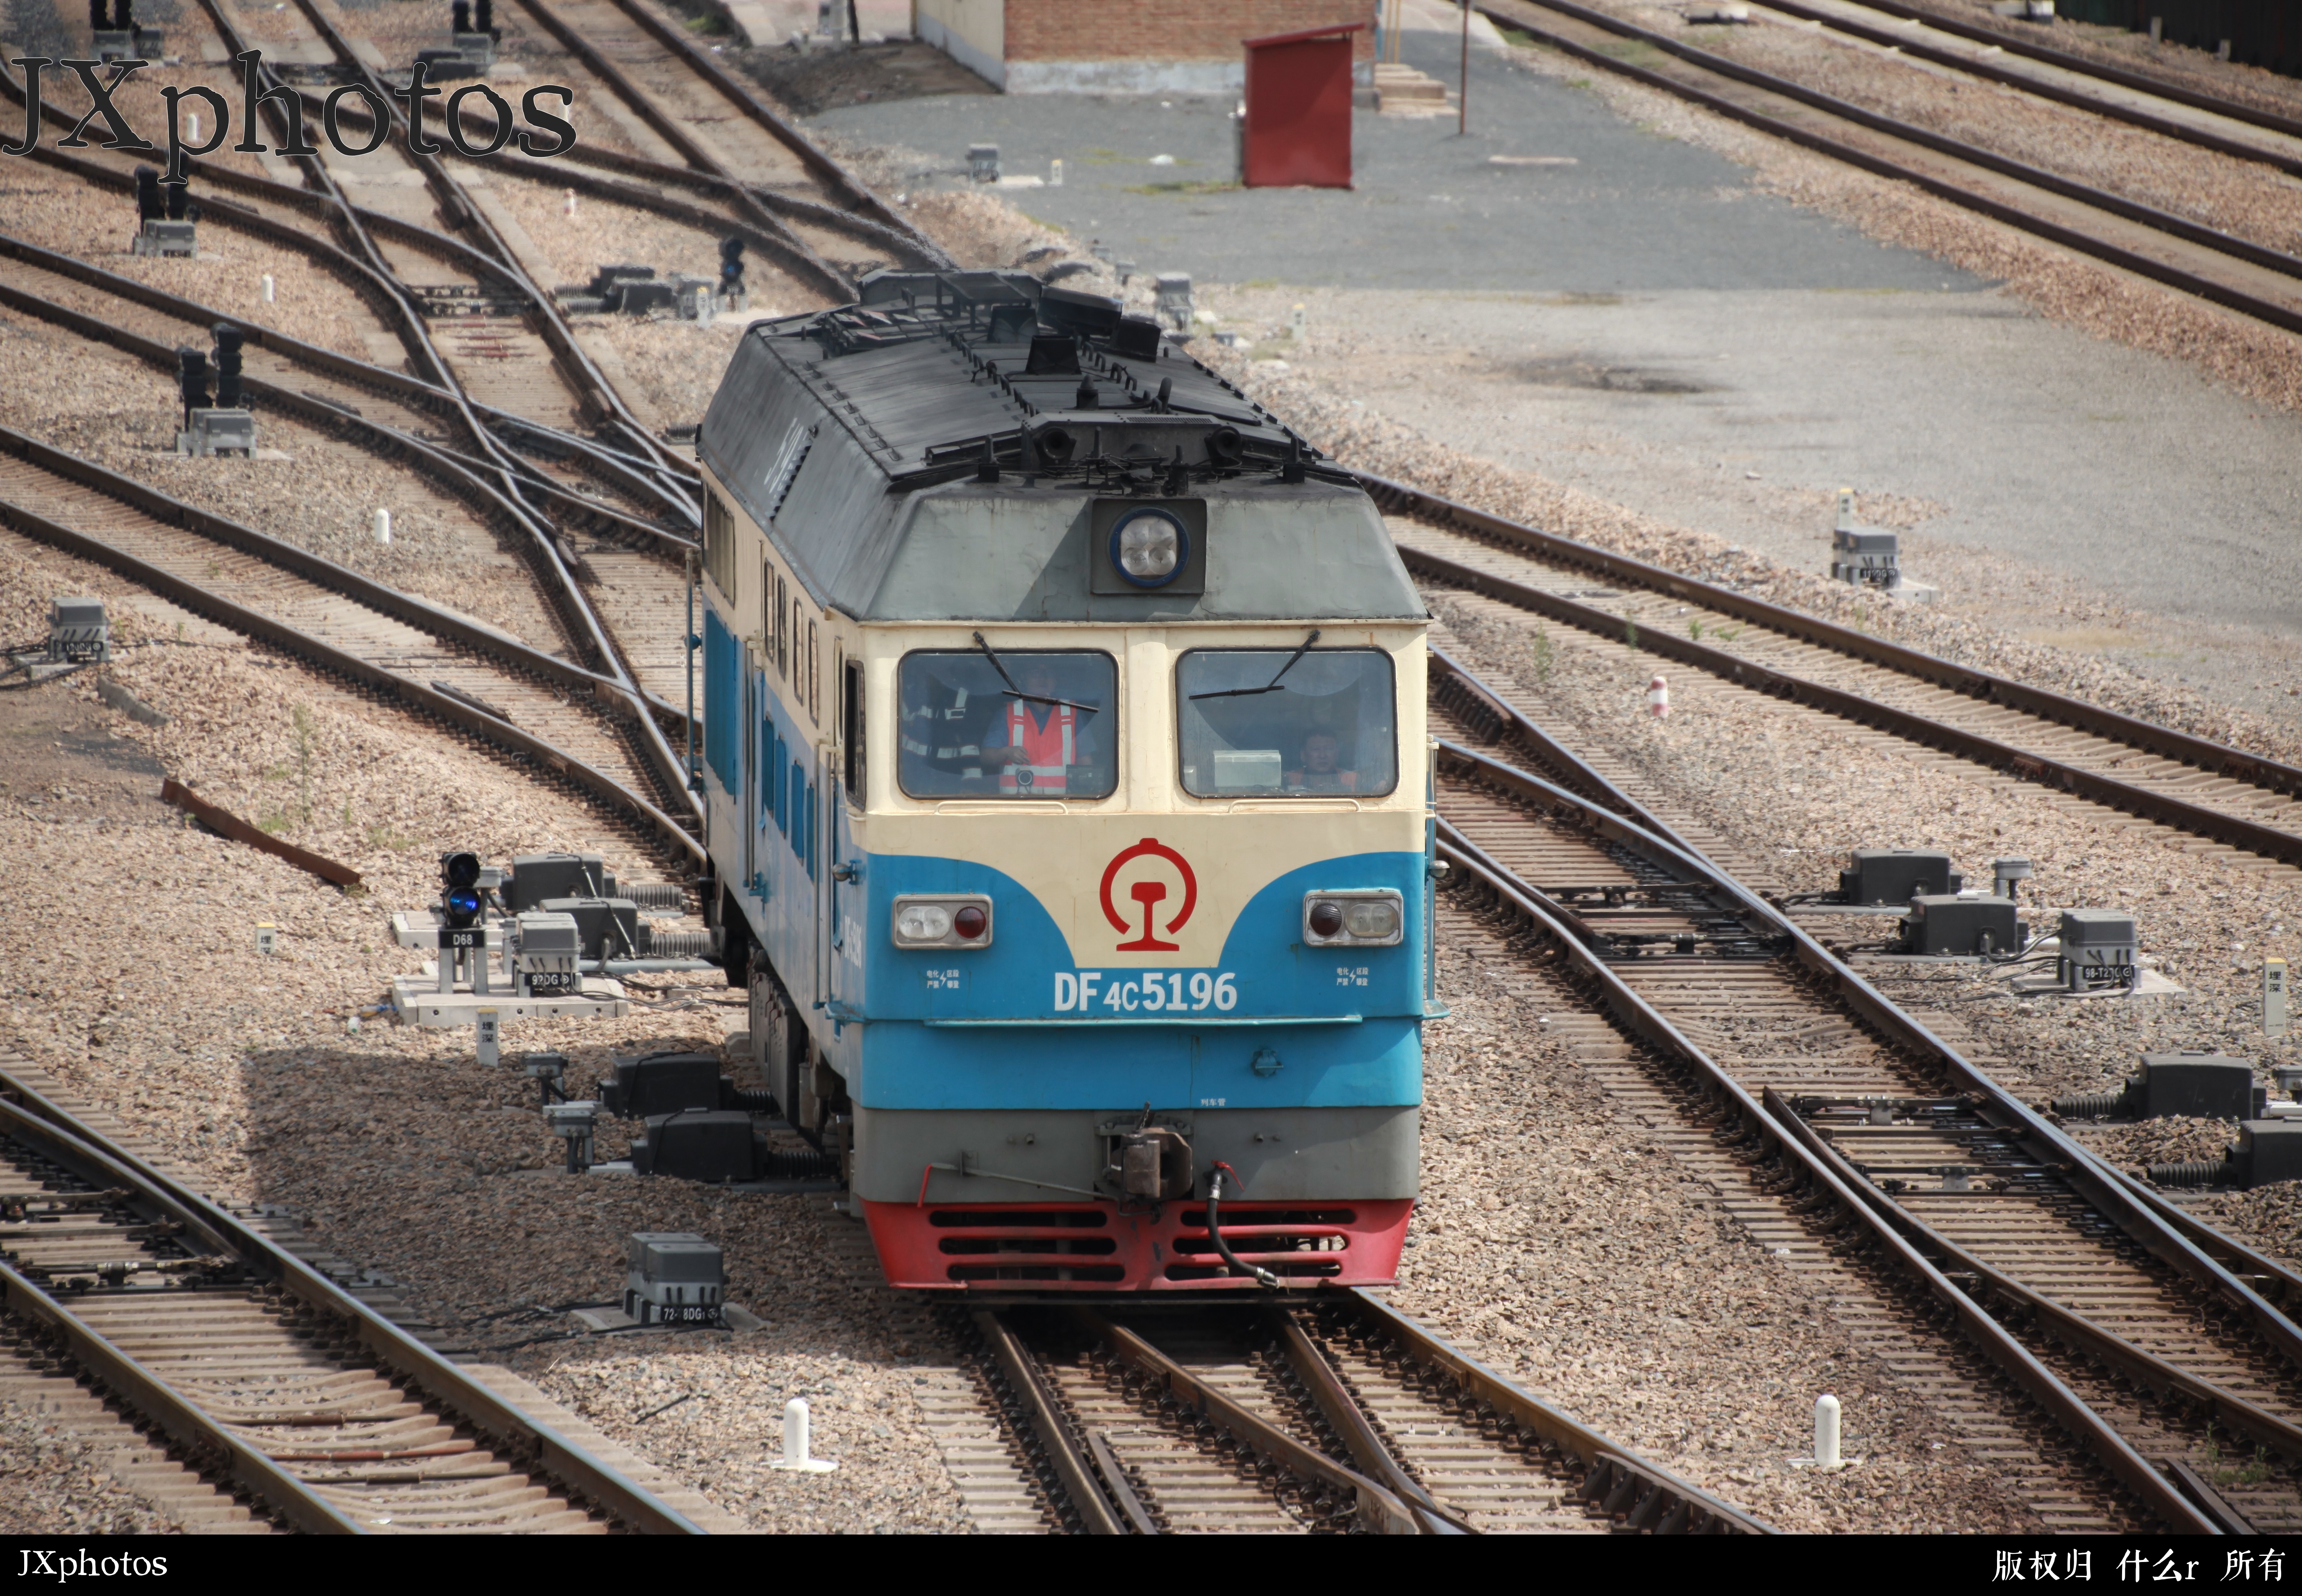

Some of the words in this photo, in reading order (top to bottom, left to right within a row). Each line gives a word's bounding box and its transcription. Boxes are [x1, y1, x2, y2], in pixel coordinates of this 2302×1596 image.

[453, 934, 473, 945] D68
[2269, 971, 2282, 993] 埋深
[1200, 1098, 1226, 1107] 列车管
